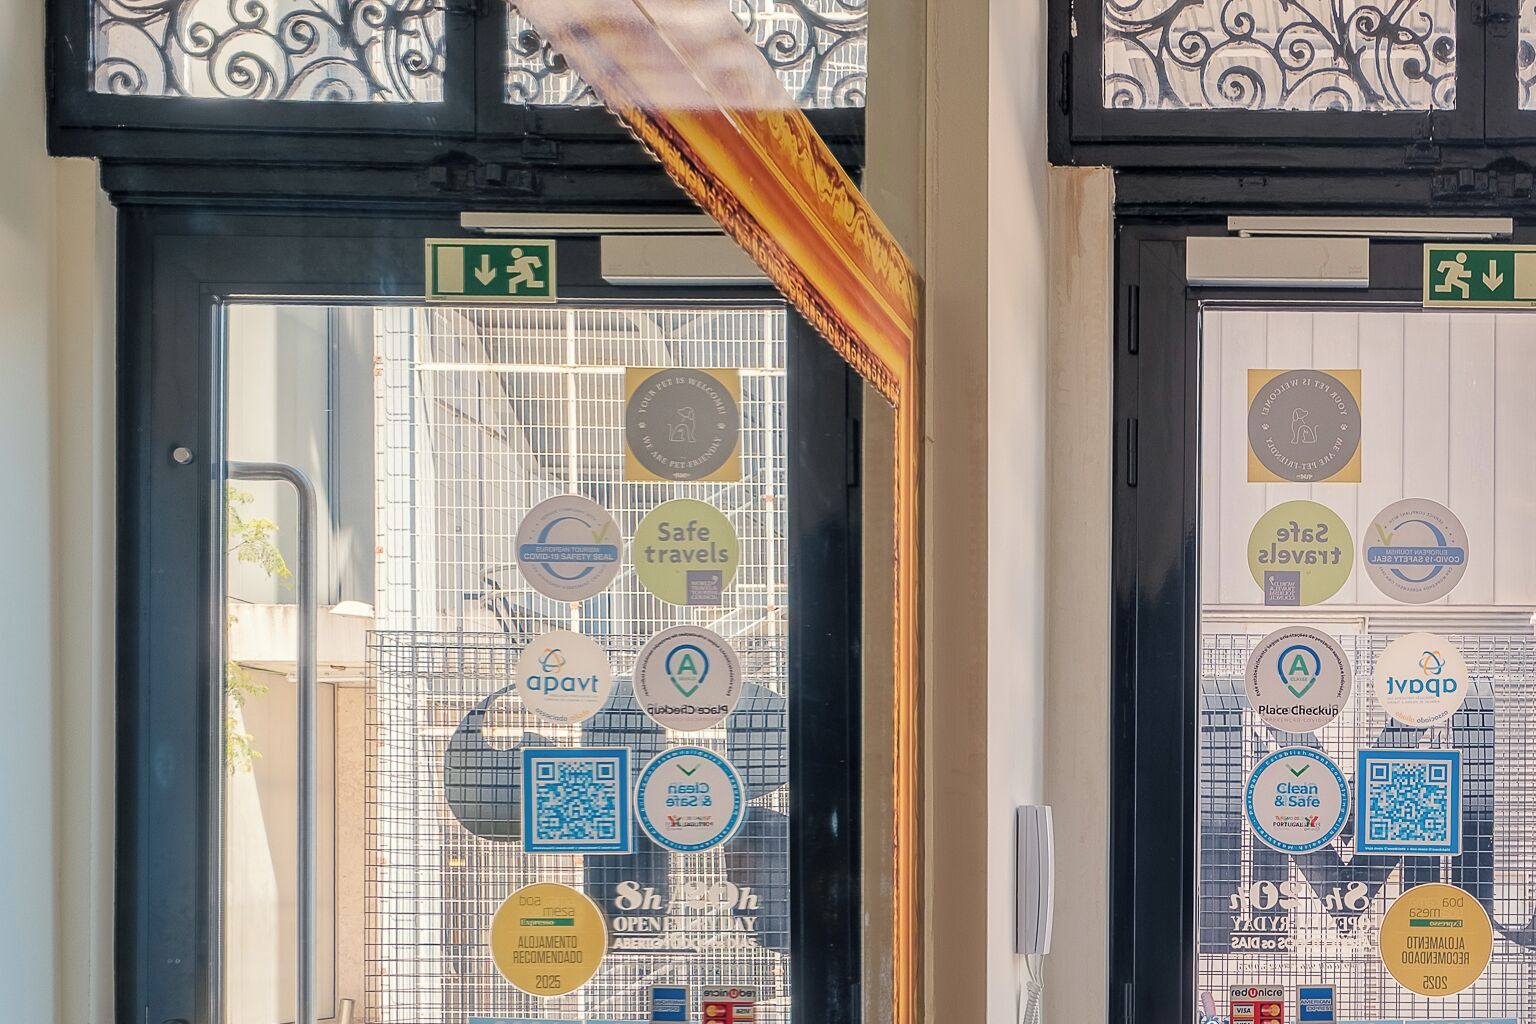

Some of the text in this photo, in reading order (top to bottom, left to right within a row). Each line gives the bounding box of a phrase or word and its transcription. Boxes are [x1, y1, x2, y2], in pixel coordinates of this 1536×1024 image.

[658, 520, 710, 542] Safe
[524, 552, 559, 561] COVID-19
[592, 553, 614, 561] SEAL
[645, 542, 729, 563] travels
[1288, 655, 1309, 676] A
[526, 674, 600, 695] apavt
[1258, 705, 1339, 717] Place Checkup
[1276, 782, 1318, 794] Clean
[1274, 795, 1320, 807] & Safe
[614, 880, 663, 911] 8h
[613, 916, 661, 932] OPEN
[517, 935, 578, 950] ALOJAMENTO
[513, 950, 582, 964] RECOMENDADO
[536, 975, 561, 989] 2025
